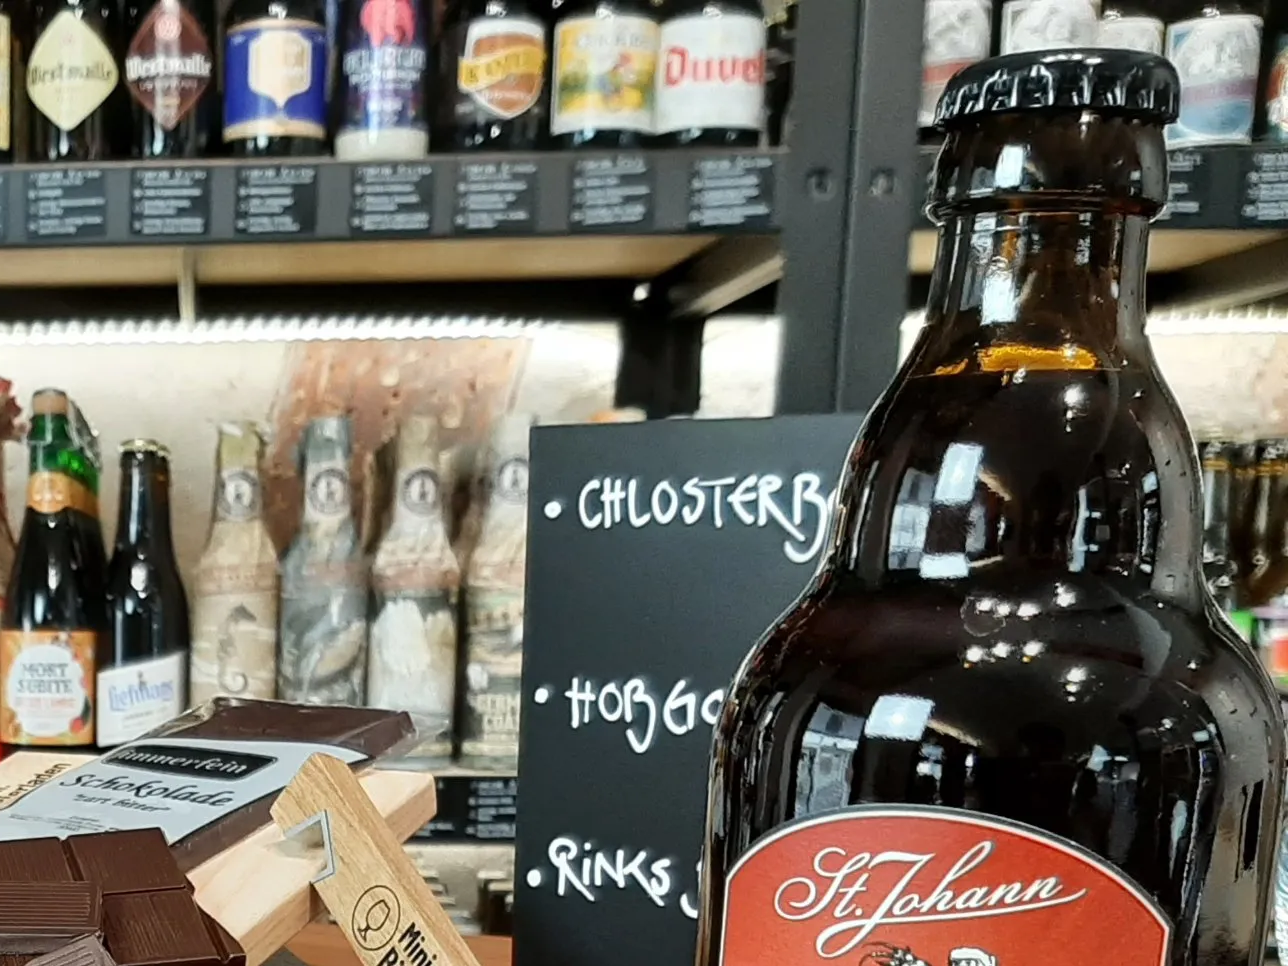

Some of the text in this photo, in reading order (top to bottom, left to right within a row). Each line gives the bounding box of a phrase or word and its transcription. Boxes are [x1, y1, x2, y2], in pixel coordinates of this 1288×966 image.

[665, 46, 765, 87] Duvel
[23, 662, 69, 678] MORT
[16, 678, 73, 695] SUBITE
[58, 773, 235, 808] Schokolade
[113, 797, 172, 813] bitter
[773, 839, 1089, 960] St. Johann
